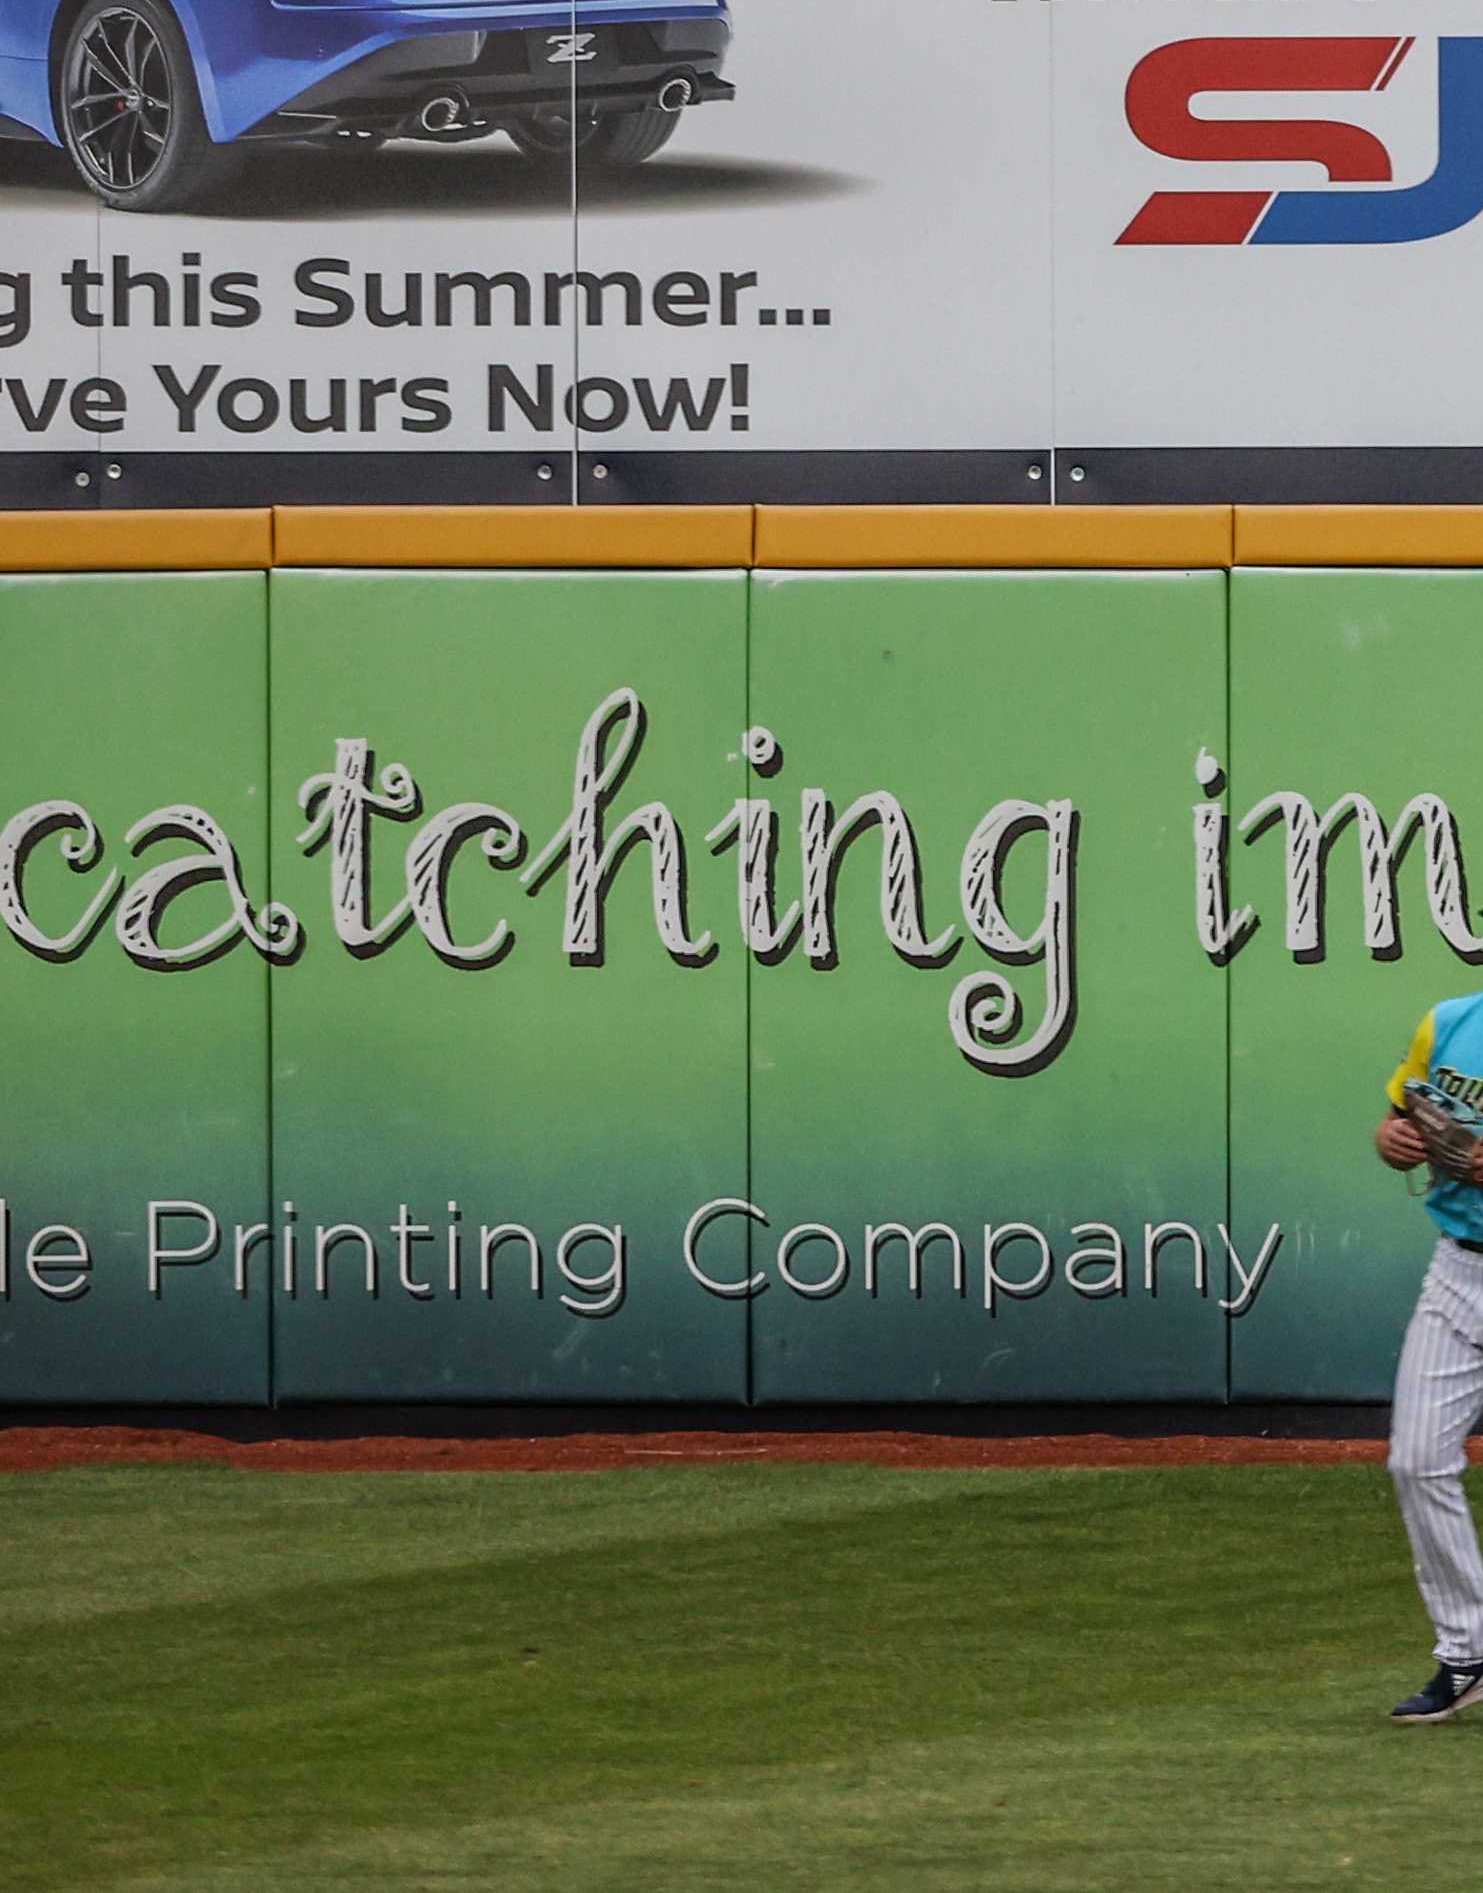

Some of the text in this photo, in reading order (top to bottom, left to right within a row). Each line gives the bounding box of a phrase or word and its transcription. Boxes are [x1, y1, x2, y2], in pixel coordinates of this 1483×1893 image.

[61, 253, 261, 328] this
[294, 256, 830, 329] Summer...
[0, 362, 749, 434] ve Yours Now!
[0, 687, 1072, 1064] catching
[148, 1201, 621, 1309] Printing
[684, 1198, 1279, 1308] Company
